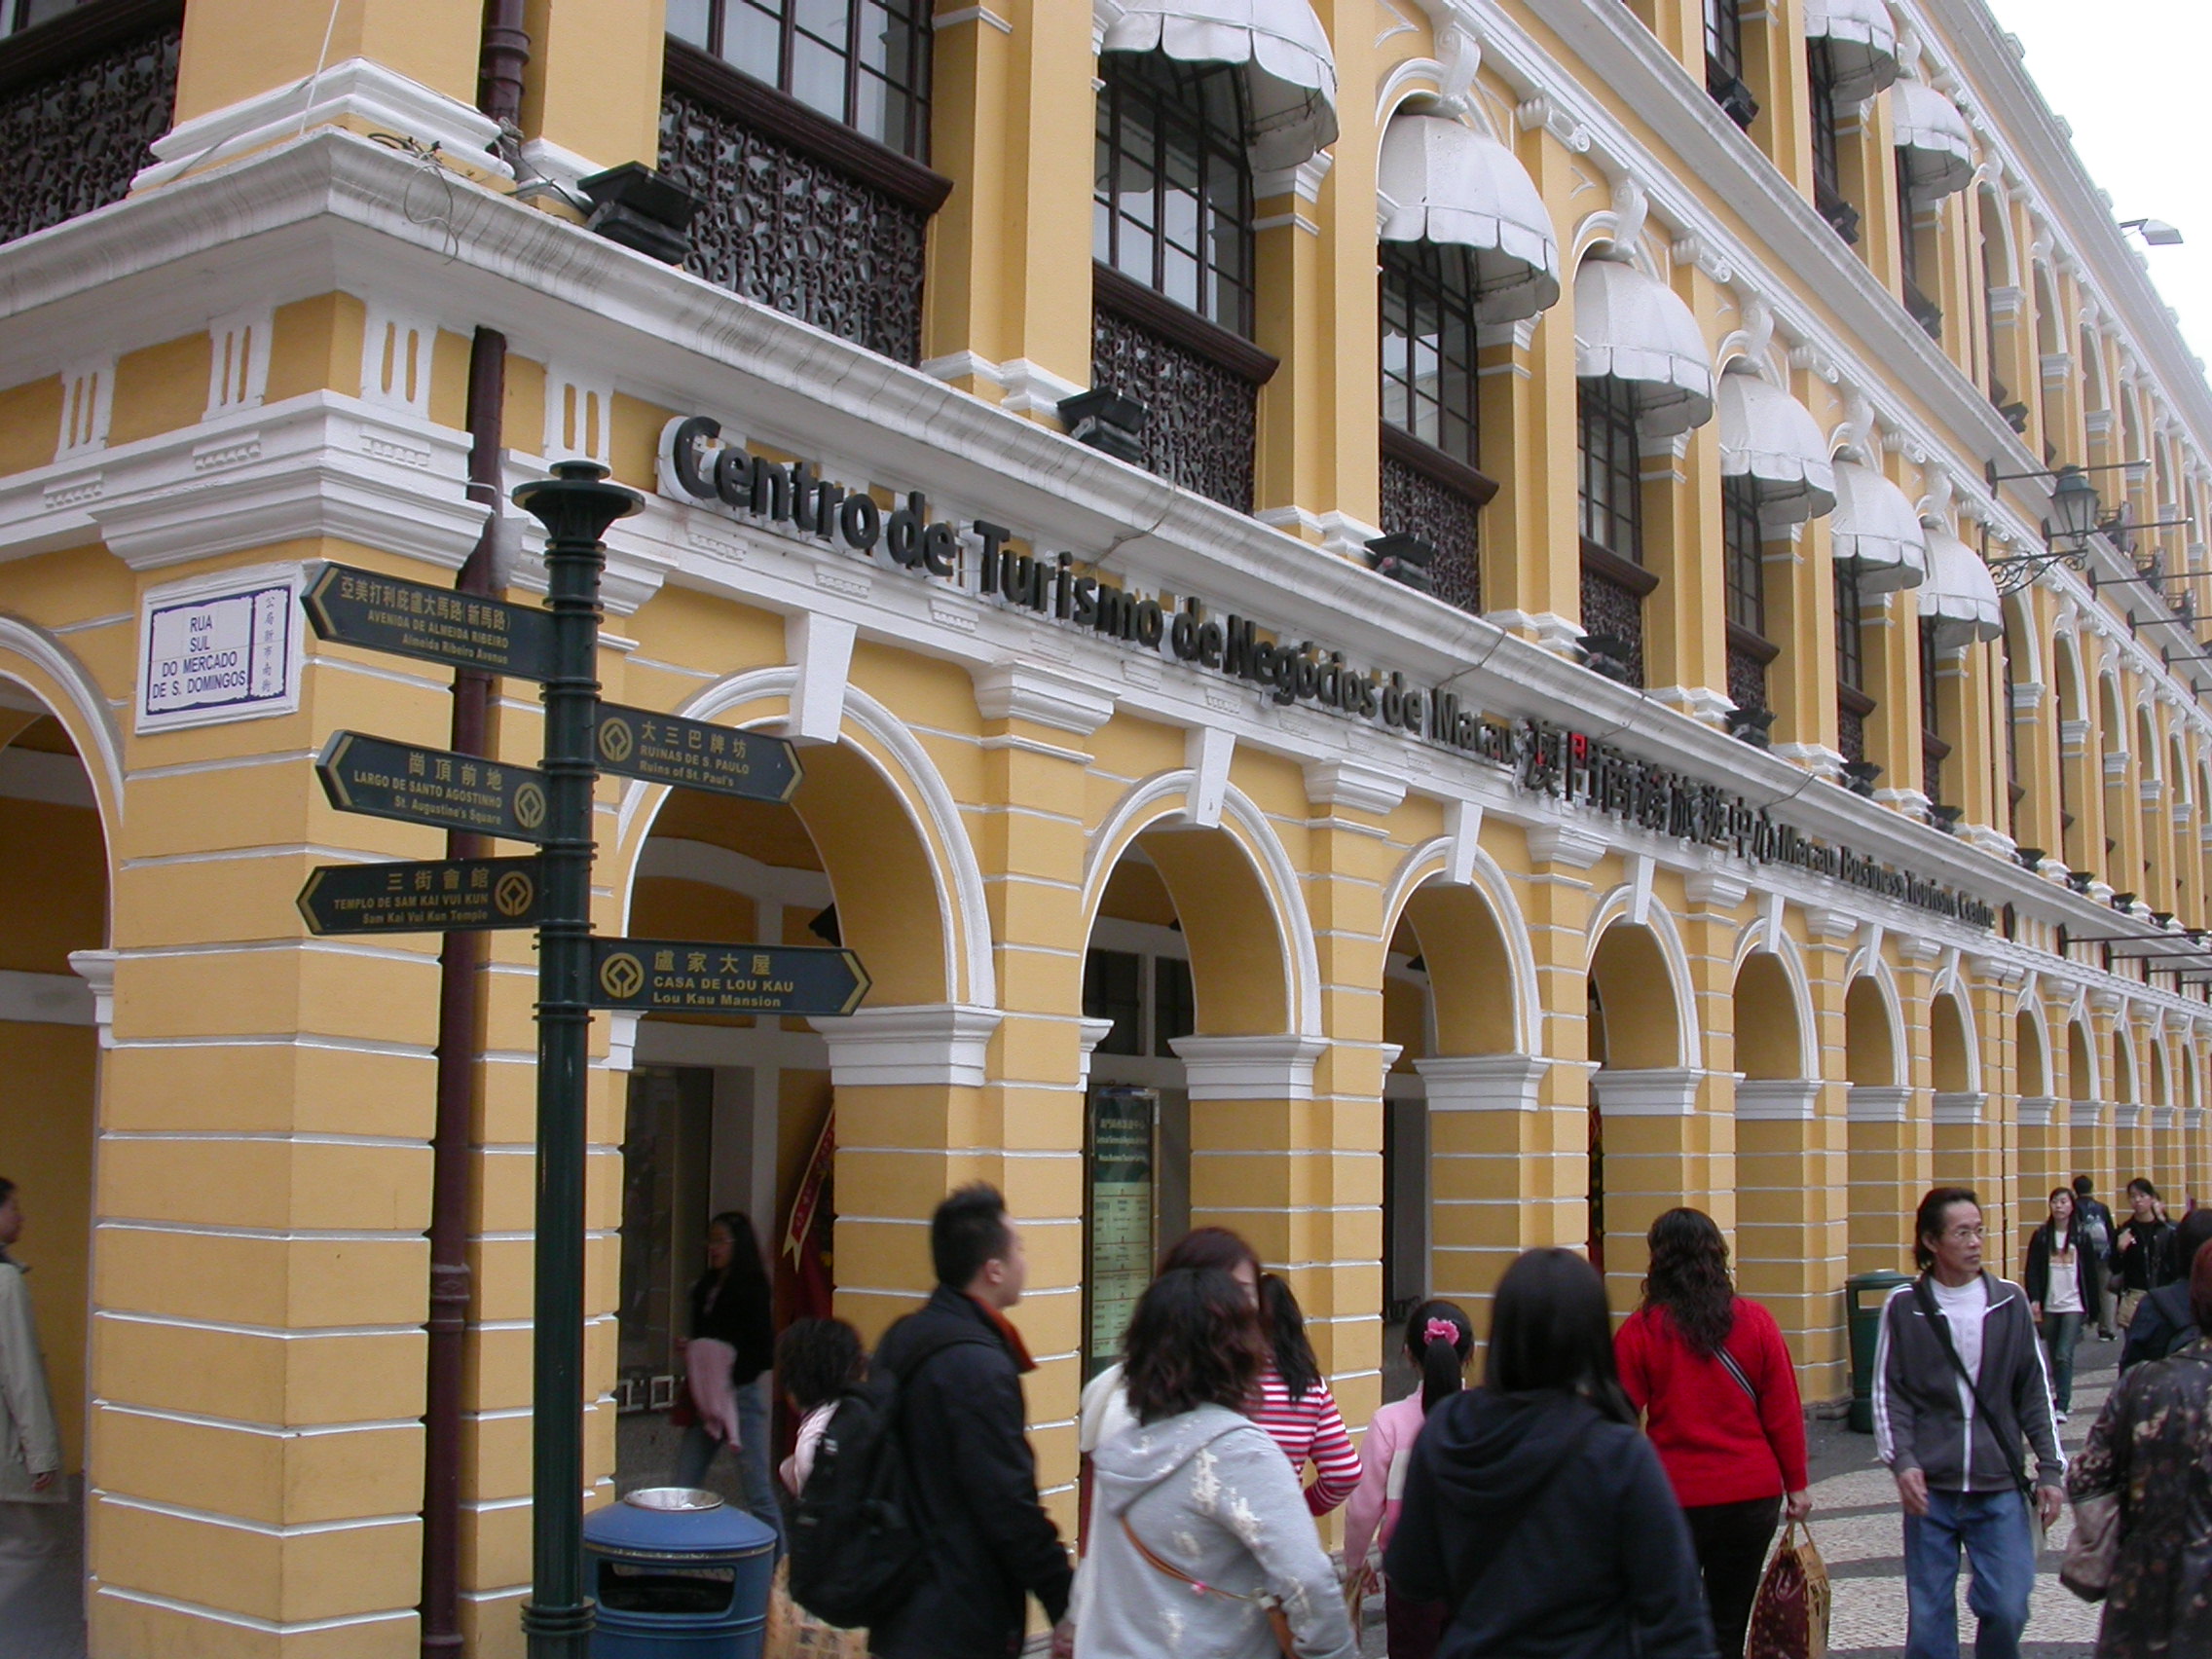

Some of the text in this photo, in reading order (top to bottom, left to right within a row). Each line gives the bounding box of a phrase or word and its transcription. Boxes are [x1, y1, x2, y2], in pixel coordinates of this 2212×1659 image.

[670, 416, 1517, 766] Centro de Turismo de Negócios de Macau
[189, 614, 213, 633] RUA
[367, 609, 509, 648] AVENIDA DE ALMEIDA RIBEIRO
[189, 635, 211, 653] SUL
[401, 633, 509, 665] Almeida Ribeiro Avenue
[162, 650, 239, 678] DO MERCADO
[152, 670, 246, 699] DE S. DOMINGOS
[641, 720, 748, 759] 大三巴牌坊
[639, 745, 751, 775] RUINAS DE S. PAULO
[639, 760, 734, 787] Ruins of St. Paul's
[353, 770, 503, 809] LARGO DE SANTO AGOSTINHO
[393, 795, 502, 825] St. Augustine's Square
[386, 866, 490, 892] 三街會館
[1778, 823, 1836, 877] Macau
[1839, 845, 1904, 899] Business
[1904, 868, 1957, 918] Tourism
[334, 892, 489, 911] TEMPLO DE SAM KAI VUI KUN
[362, 909, 489, 926] Sam Kai Vui Kun Temple
[653, 949, 772, 976] 盧家大屋
[653, 976, 794, 993] CASA DE LOU KAU
[653, 991, 782, 1008] Lou Kau Mansion
